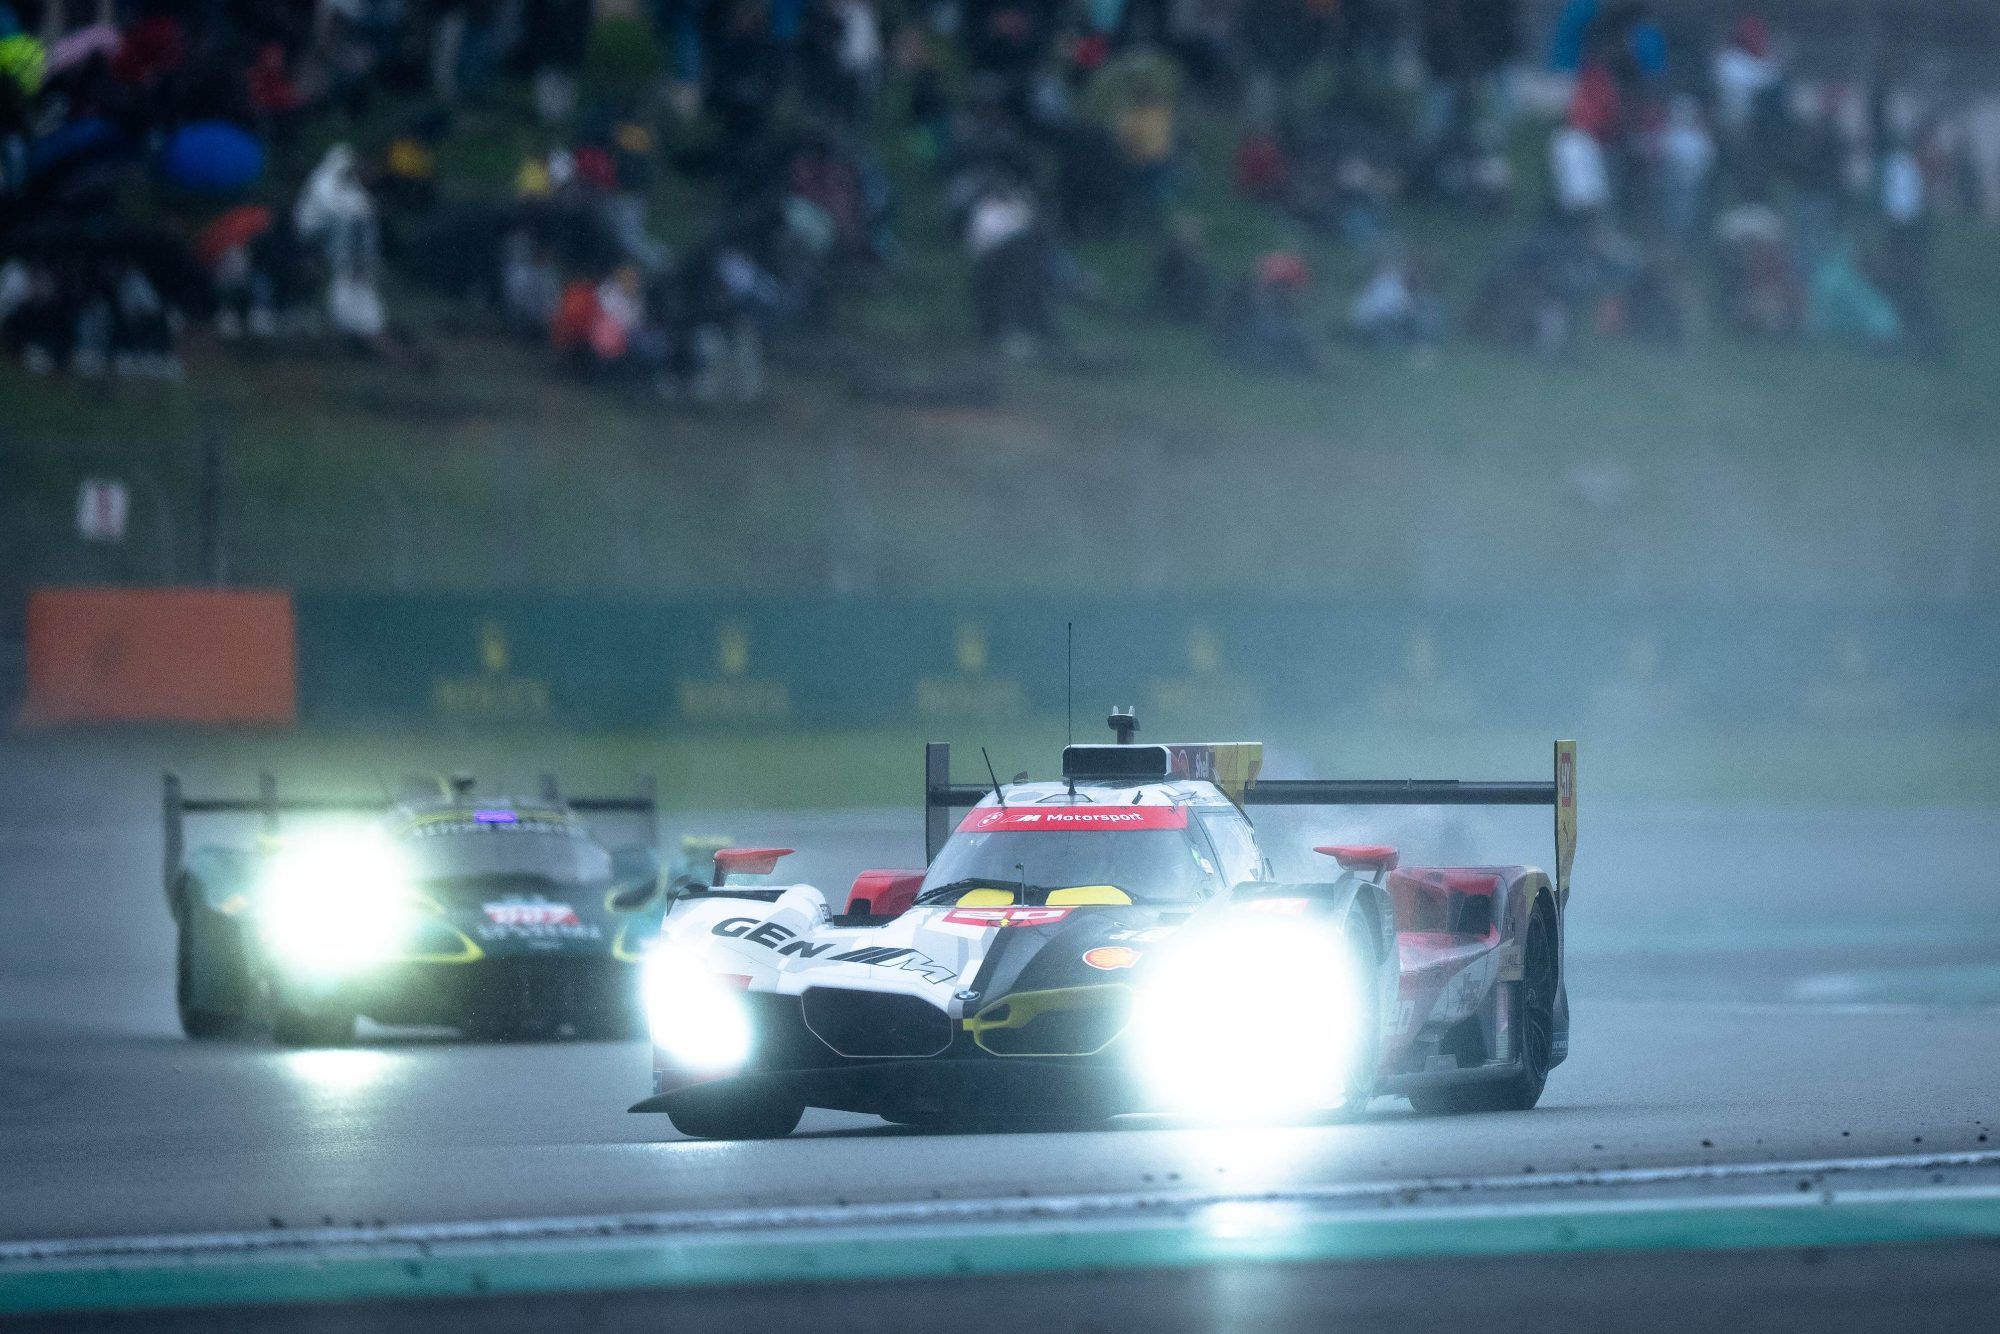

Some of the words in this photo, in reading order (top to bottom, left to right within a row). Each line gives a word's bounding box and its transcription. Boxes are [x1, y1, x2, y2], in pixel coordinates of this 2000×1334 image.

[1046, 812, 1144, 822] Motorsport
[952, 910, 1067, 921] 20
[711, 917, 837, 958] GEN
